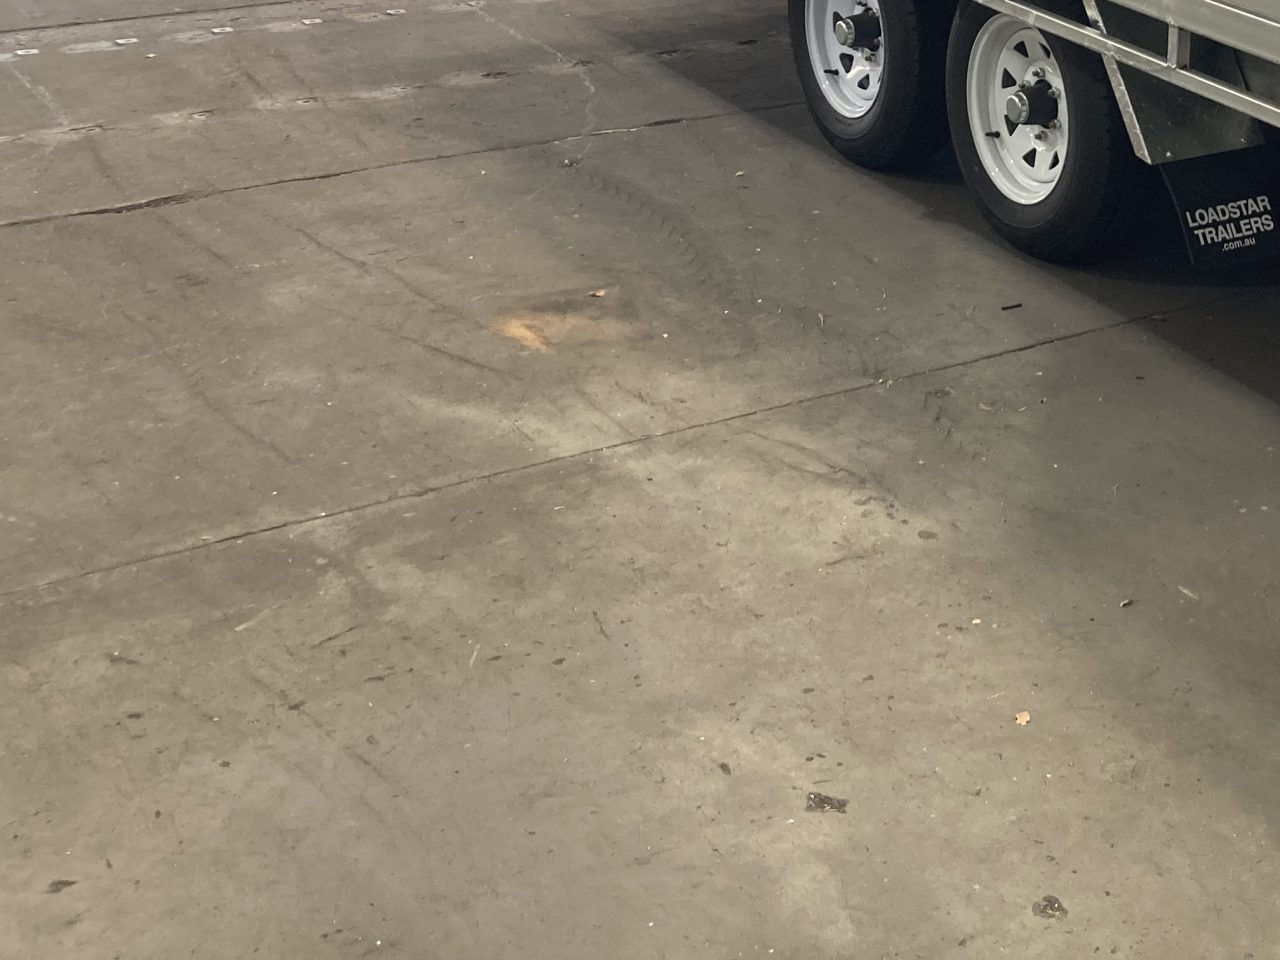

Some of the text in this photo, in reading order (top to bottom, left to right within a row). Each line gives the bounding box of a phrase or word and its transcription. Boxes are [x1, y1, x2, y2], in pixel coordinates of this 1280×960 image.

[1186, 195, 1271, 227] LOADSTAR
[1194, 214, 1274, 246] TRAILERS
[1222, 237, 1256, 252] .com.au
